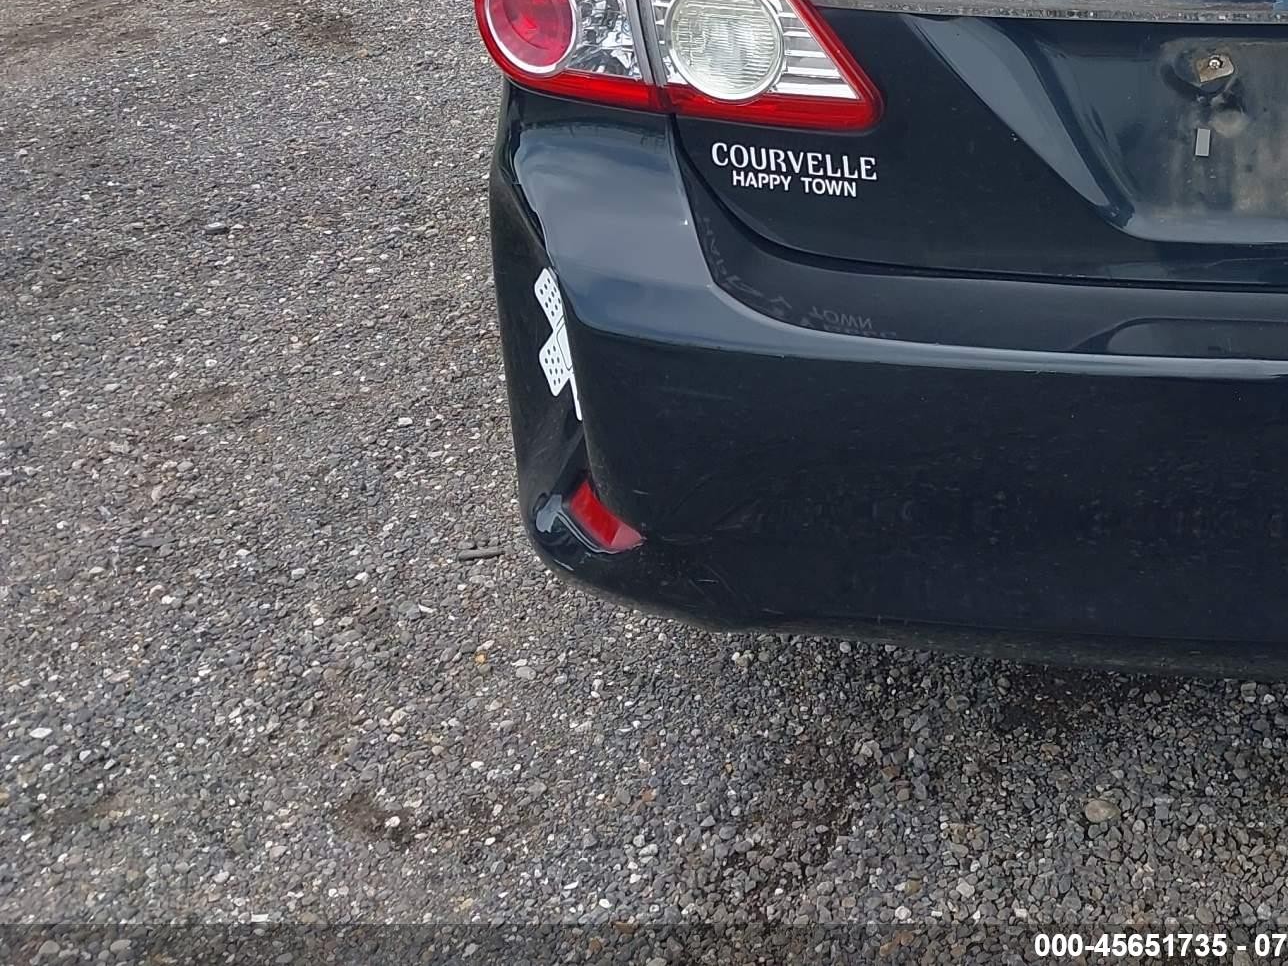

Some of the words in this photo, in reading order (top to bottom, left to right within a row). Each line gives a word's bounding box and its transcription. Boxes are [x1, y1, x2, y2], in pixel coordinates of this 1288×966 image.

[711, 142, 878, 180] COURVELLE
[732, 170, 792, 192] HAPPY
[801, 177, 857, 197] TOWN
